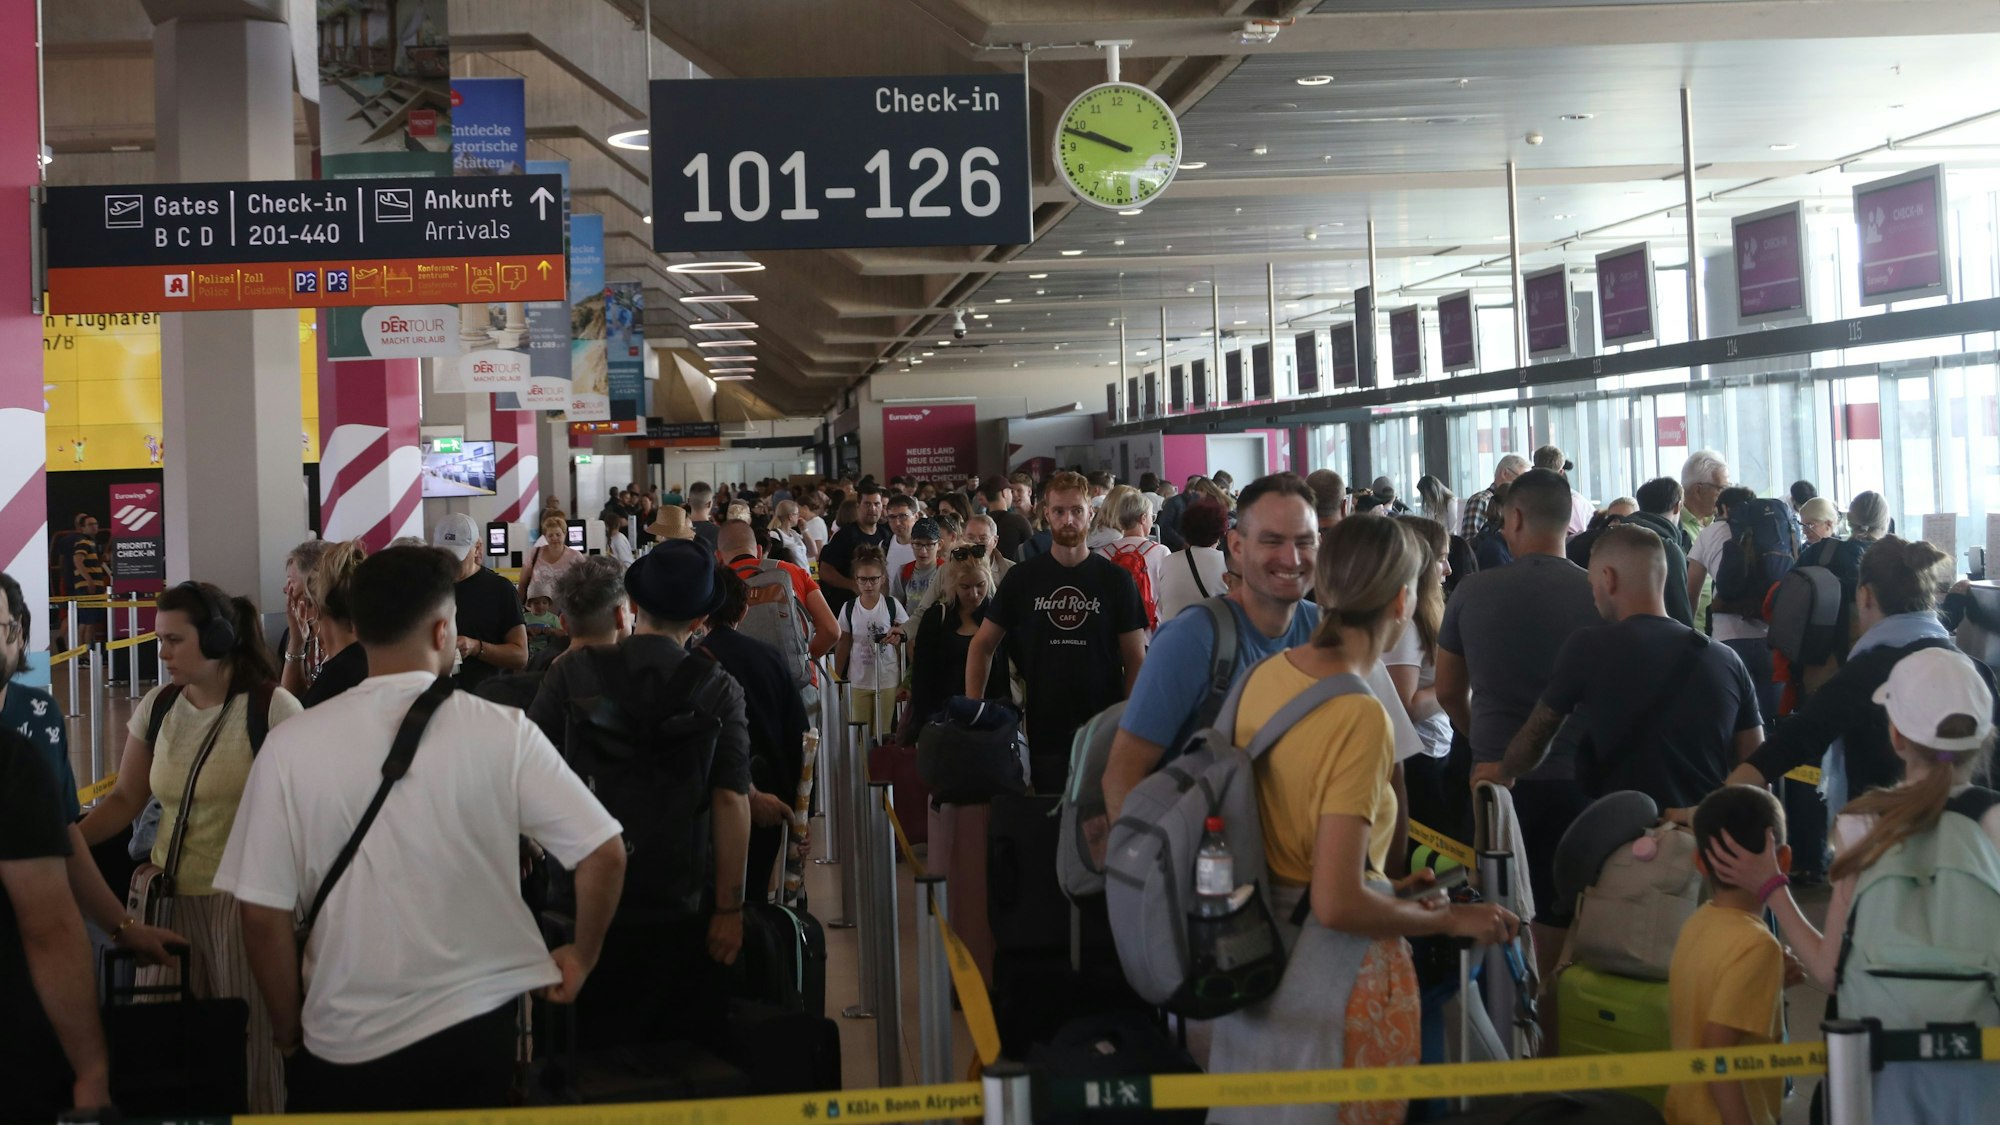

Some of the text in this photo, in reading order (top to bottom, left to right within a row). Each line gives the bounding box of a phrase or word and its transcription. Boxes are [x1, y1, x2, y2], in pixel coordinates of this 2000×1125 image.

[876, 87, 999, 113] Check-in
[1112, 97, 1123, 106] 12
[1091, 105, 1101, 113] 11
[1137, 104, 1142, 113] 1
[1074, 121, 1086, 130] 10
[1152, 121, 1158, 129] 2
[453, 140, 518, 152] storische
[1070, 142, 1076, 151] 9
[1160, 141, 1166, 150] 3
[453, 157, 505, 168] Stätten
[1152, 162, 1158, 170] 4
[1078, 164, 1084, 173] 8
[683, 146, 1001, 223] 101-126
[1093, 182, 1099, 190] 7
[1139, 180, 1145, 189] 5
[1116, 187, 1122, 195] 6
[247, 192, 347, 214] Check-in
[424, 188, 513, 209] Ankunft
[154, 195, 219, 216] Gates
[249, 223, 340, 246] 201-440
[425, 219, 511, 241] Arrivals
[155, 226, 214, 247] B C D
[417, 264, 459, 272] Konferenz-
[471, 266, 493, 276] Taxi
[198, 273, 235, 284] Polizei
[244, 273, 264, 283] Zoll
[418, 272, 449, 280] zentrum
[381, 316, 445, 333] DERTOUR
[1847, 321, 1862, 341] 115
[381, 335, 445, 345] MACHT URLAUB
[1727, 339, 1738, 356] 114
[473, 360, 521, 374] DERTOUR
[889, 412, 923, 422] Eurowings
[906, 447, 955, 455] NEUES LAND
[929, 456, 955, 464] ECKEN
[116, 541, 156, 550] PRIORITY-
[116, 549, 155, 558] CHECK-IN
[1033, 595, 1101, 614] Hard Rock
[1059, 614, 1077, 622] CAFE
[1734, 1056, 1764, 1070] Köln
[1770, 1054, 1803, 1068] Bonn
[847, 1094, 981, 1114] Köln Bonn Airport
